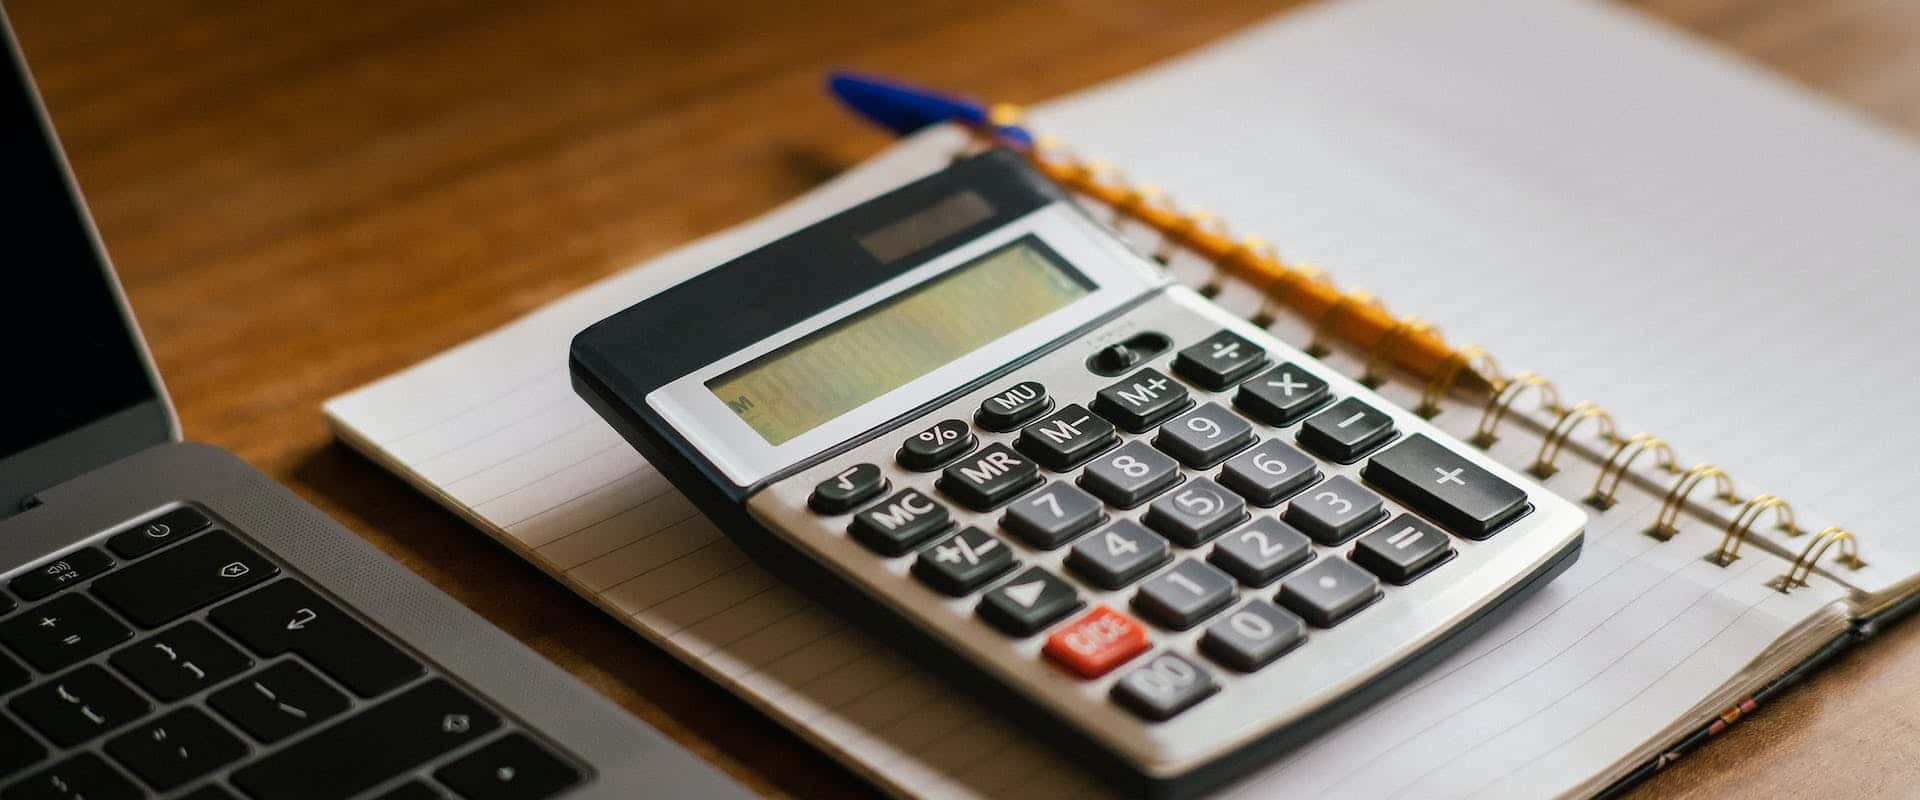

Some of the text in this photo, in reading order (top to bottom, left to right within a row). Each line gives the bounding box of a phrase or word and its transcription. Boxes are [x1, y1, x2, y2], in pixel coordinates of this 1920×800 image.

[994, 385, 1036, 410] MU
[1117, 376, 1167, 406] M+
[920, 426, 958, 446] %
[1039, 415, 1089, 443] M-
[1187, 417, 1221, 438] 9
[960, 451, 1021, 484] MR
[1112, 455, 1149, 477] 8
[1252, 453, 1287, 475] 6
[872, 494, 933, 530] MC
[1032, 492, 1064, 518] 7
[1175, 490, 1214, 516] 5
[1315, 492, 1352, 515] 3
[1105, 531, 1140, 556] 4
[1241, 531, 1283, 557] 2
[1167, 572, 1205, 594] 1
[1230, 611, 1273, 638] 0
